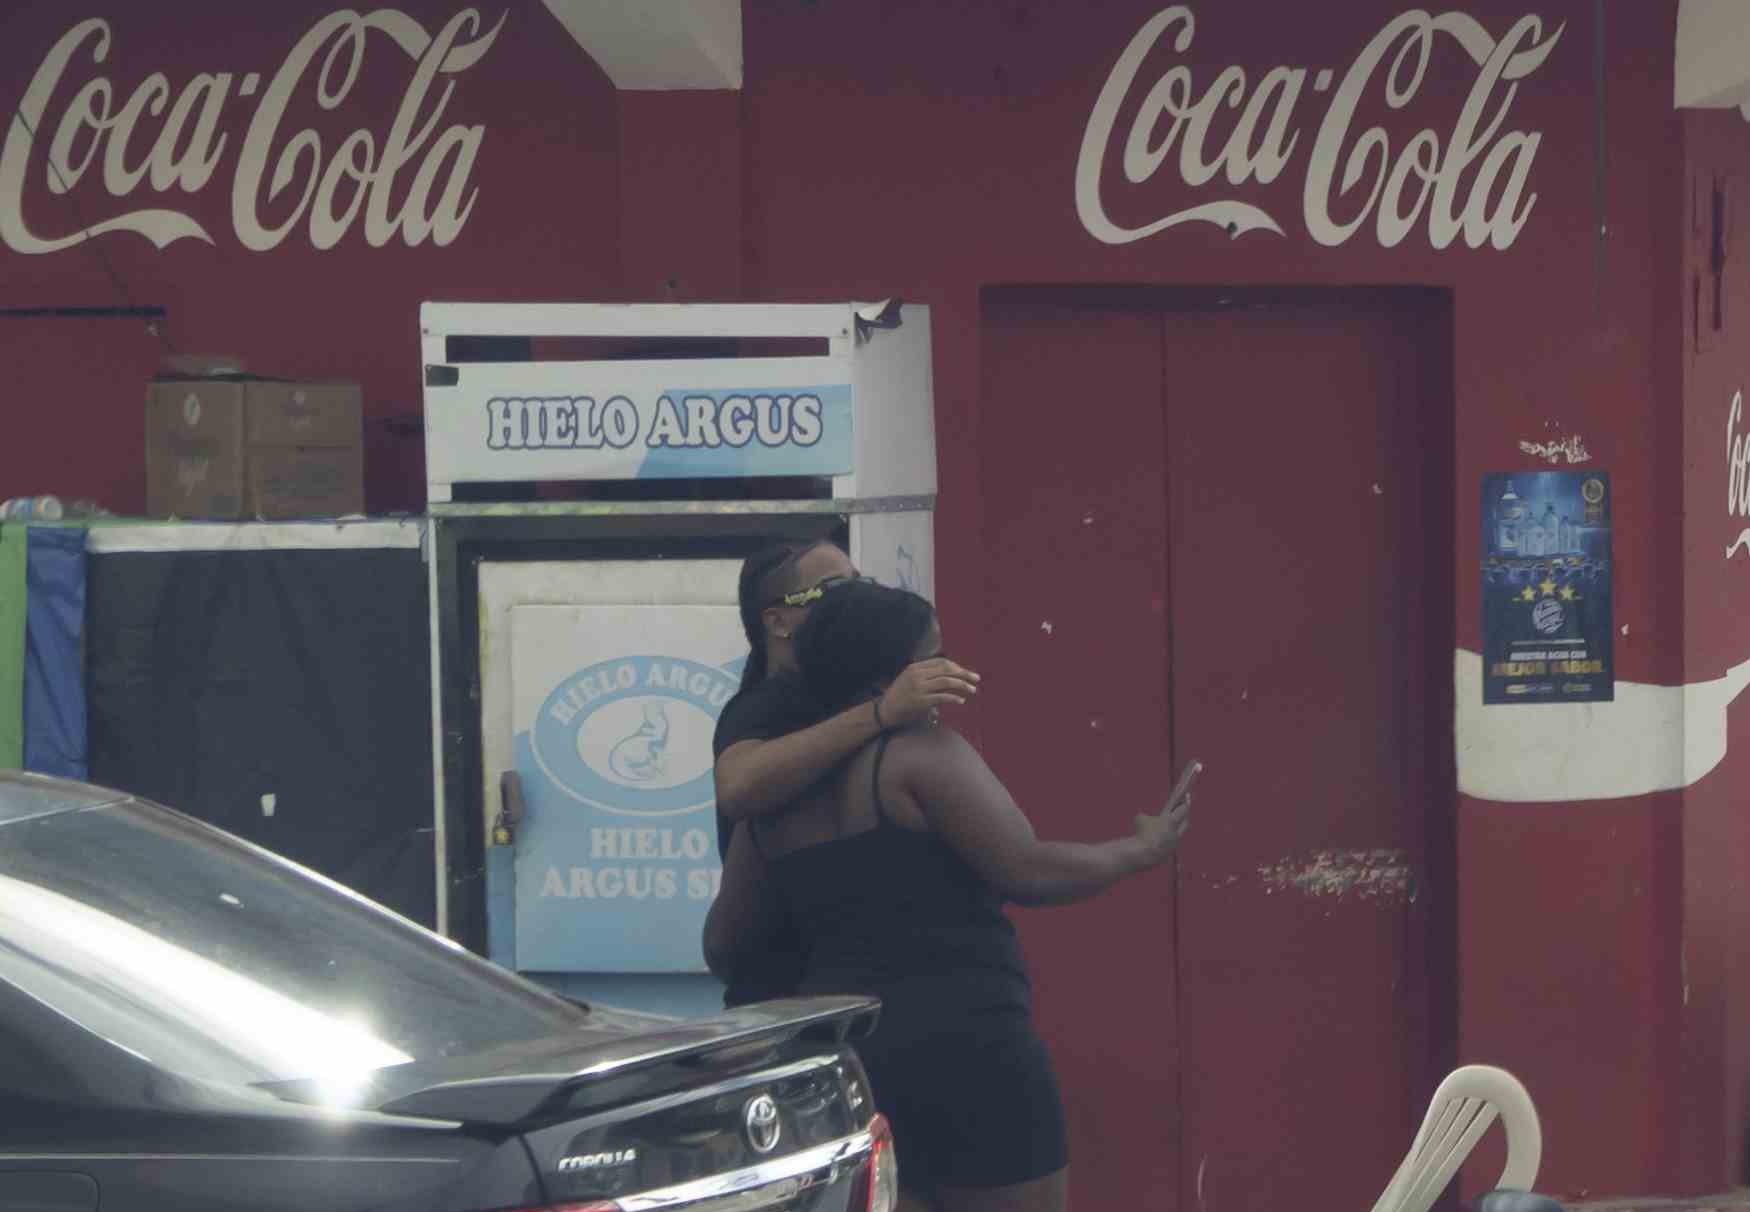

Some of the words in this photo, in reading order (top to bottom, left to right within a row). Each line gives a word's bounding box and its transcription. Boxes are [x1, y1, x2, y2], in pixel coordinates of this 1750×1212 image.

[487, 394, 640, 450] HIELO
[646, 393, 823, 450] ARGUS
[550, 663, 638, 727] HIELO
[646, 662, 738, 708] ARGU
[590, 826, 710, 860] HIELO
[540, 865, 677, 900] ARGUS
